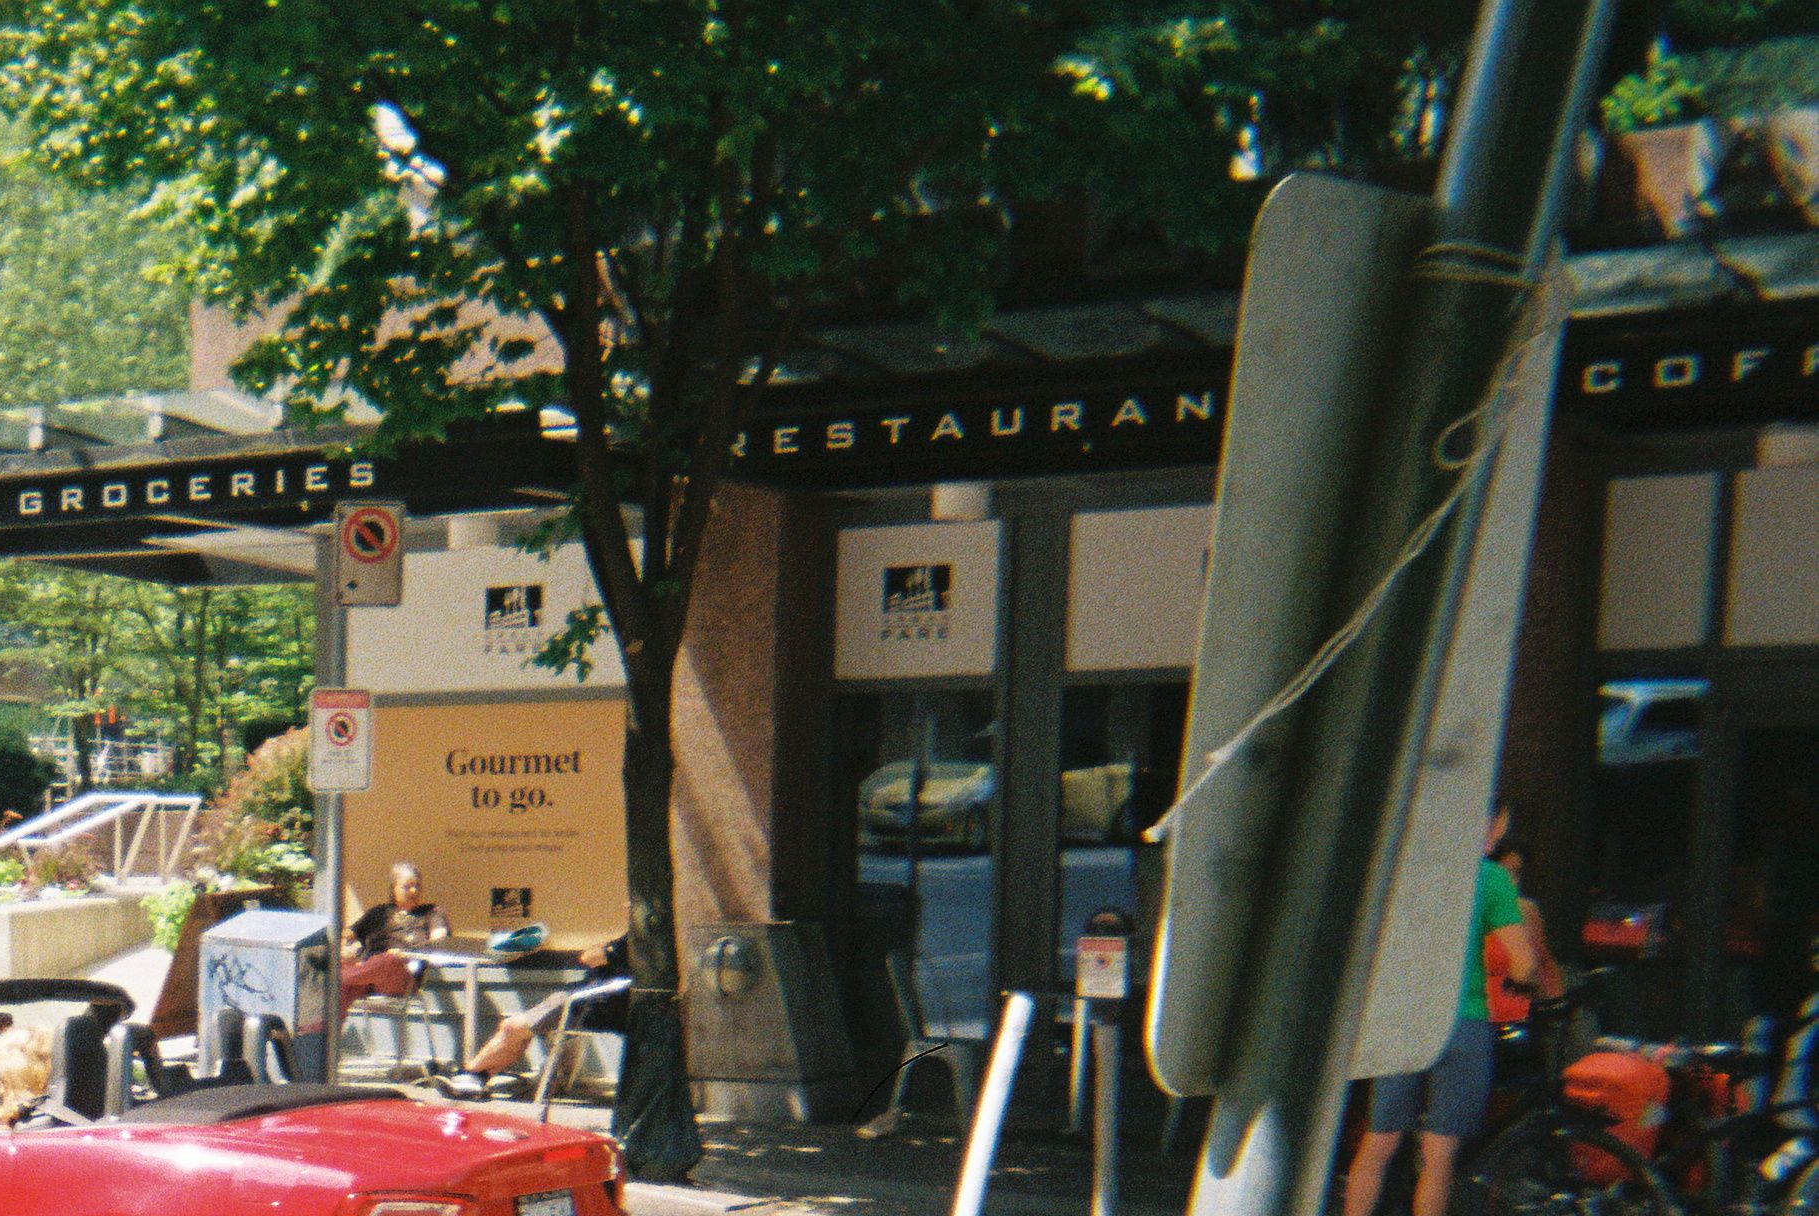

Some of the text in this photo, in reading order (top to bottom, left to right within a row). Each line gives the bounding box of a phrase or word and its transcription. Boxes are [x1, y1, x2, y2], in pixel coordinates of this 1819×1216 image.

[18, 461, 376, 516] GROCERIES
[446, 750, 580, 776] Gourmet
[472, 787, 553, 814] to go.
